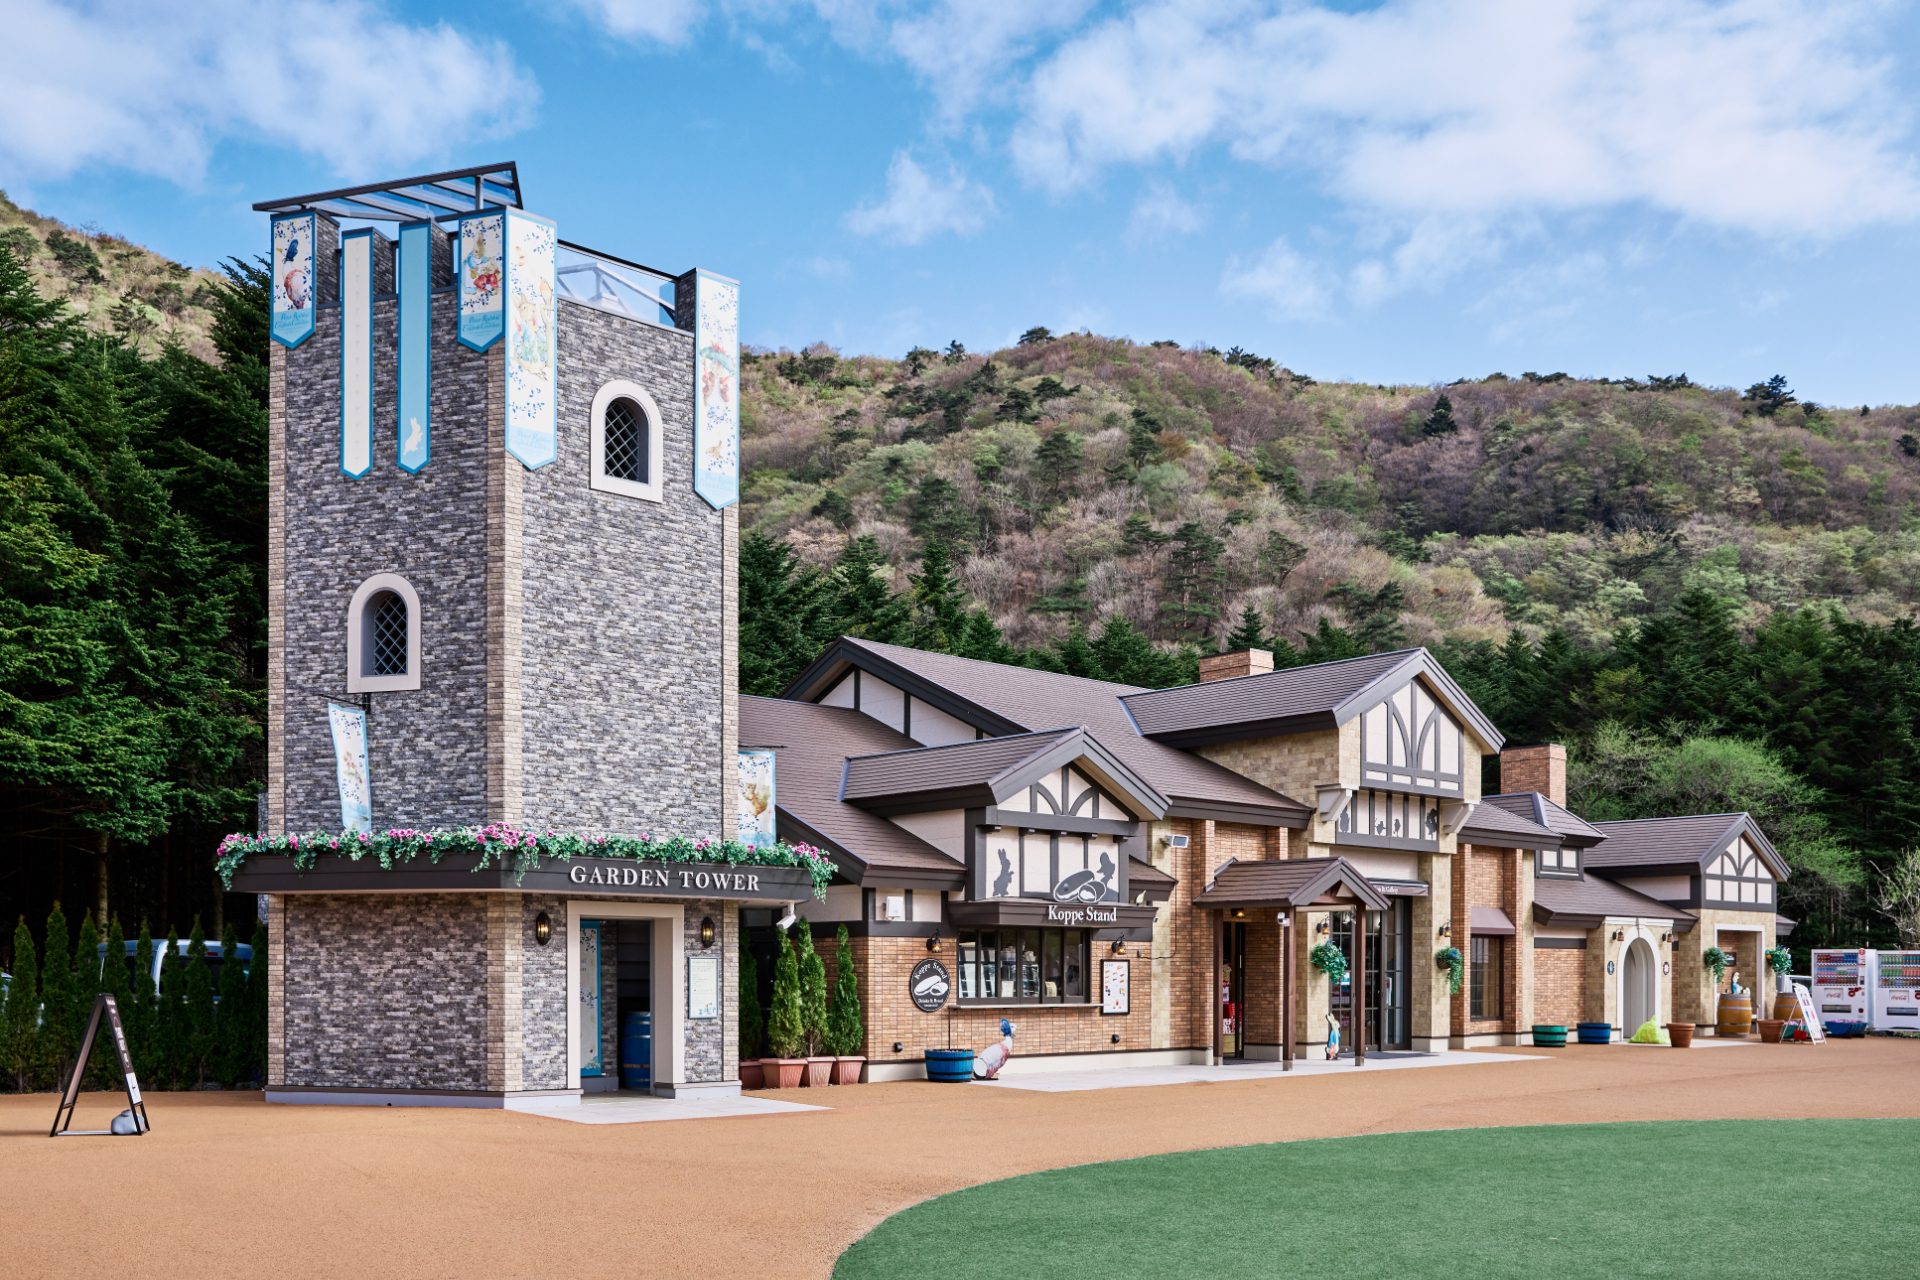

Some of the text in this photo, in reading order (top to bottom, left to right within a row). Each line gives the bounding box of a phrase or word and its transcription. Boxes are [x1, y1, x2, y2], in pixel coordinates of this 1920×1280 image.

[570, 865, 760, 891] GARDEN TOWER
[1048, 905, 1117, 925] Koppe Stand
[914, 962, 948, 980] Koppe Stand
